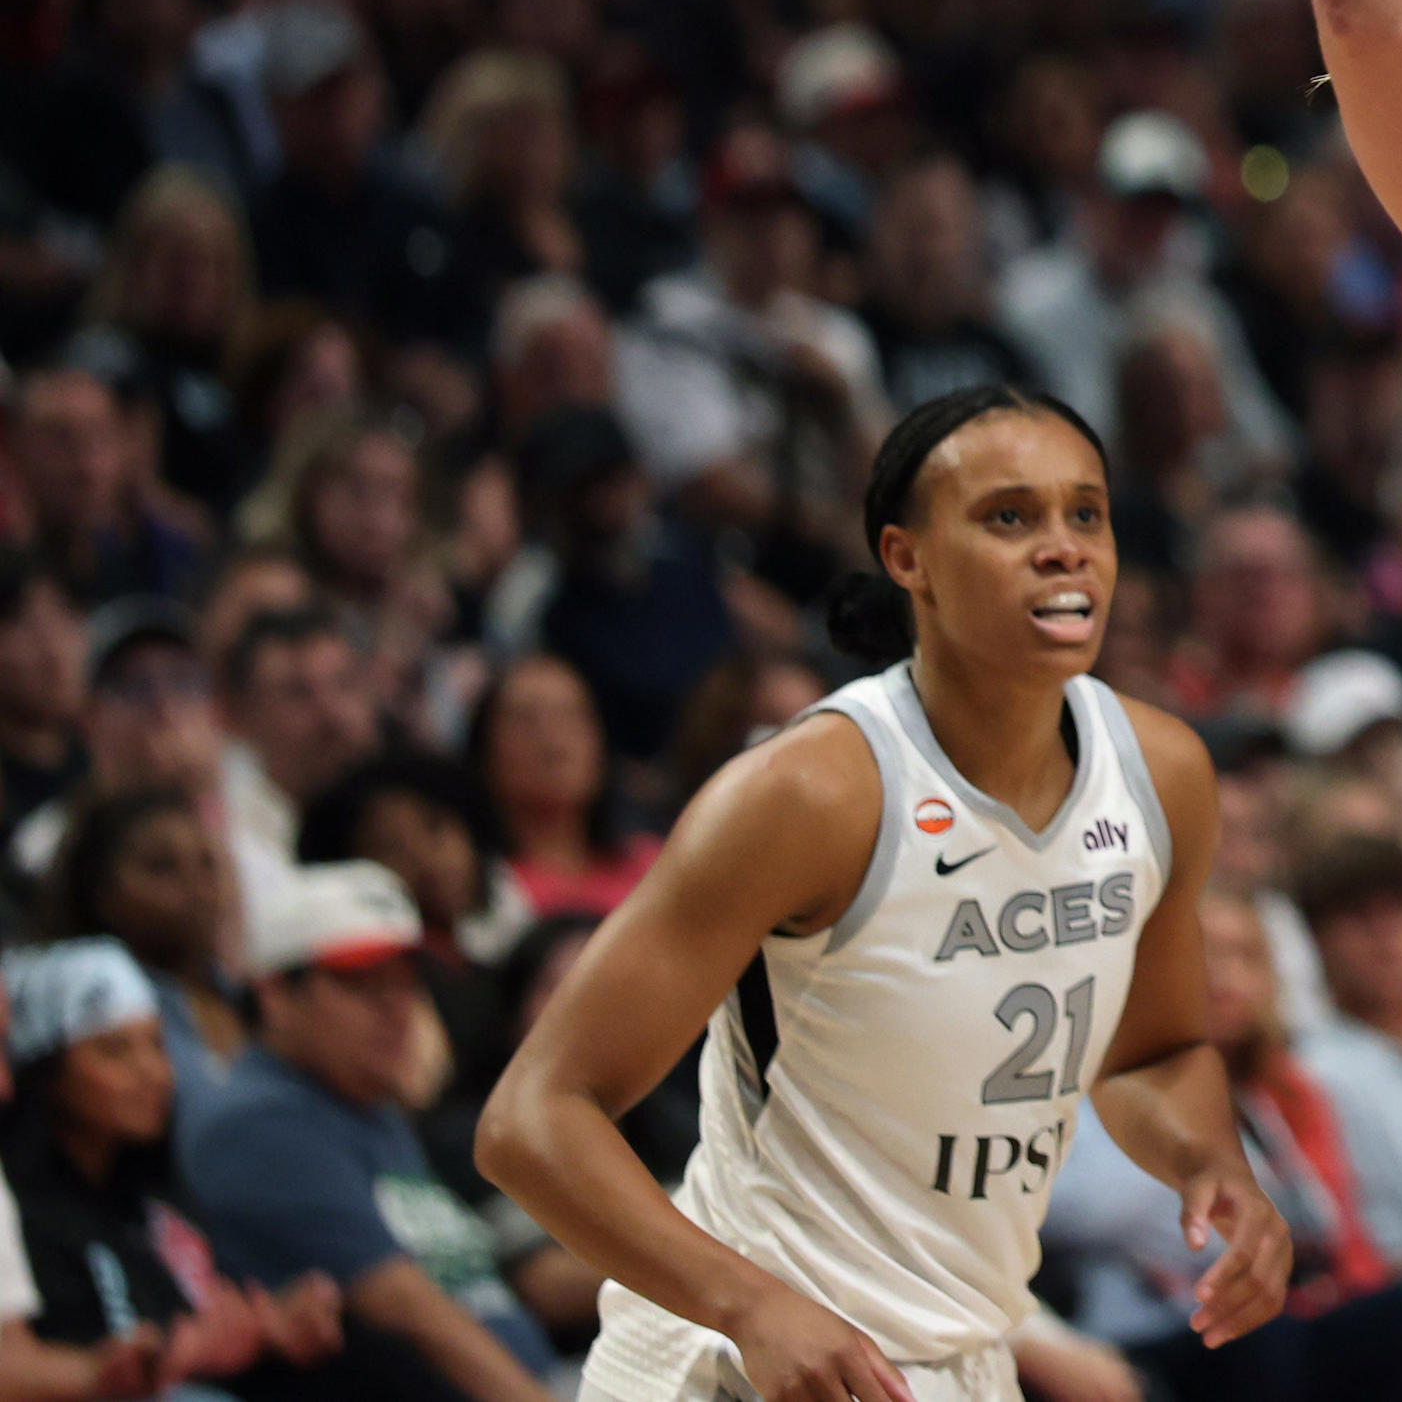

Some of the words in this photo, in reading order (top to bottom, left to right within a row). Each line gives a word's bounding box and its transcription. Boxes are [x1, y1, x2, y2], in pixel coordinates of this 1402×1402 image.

[1083, 818, 1129, 853] ally
[934, 871, 1135, 963] ACES
[981, 973, 1096, 1105] 21
